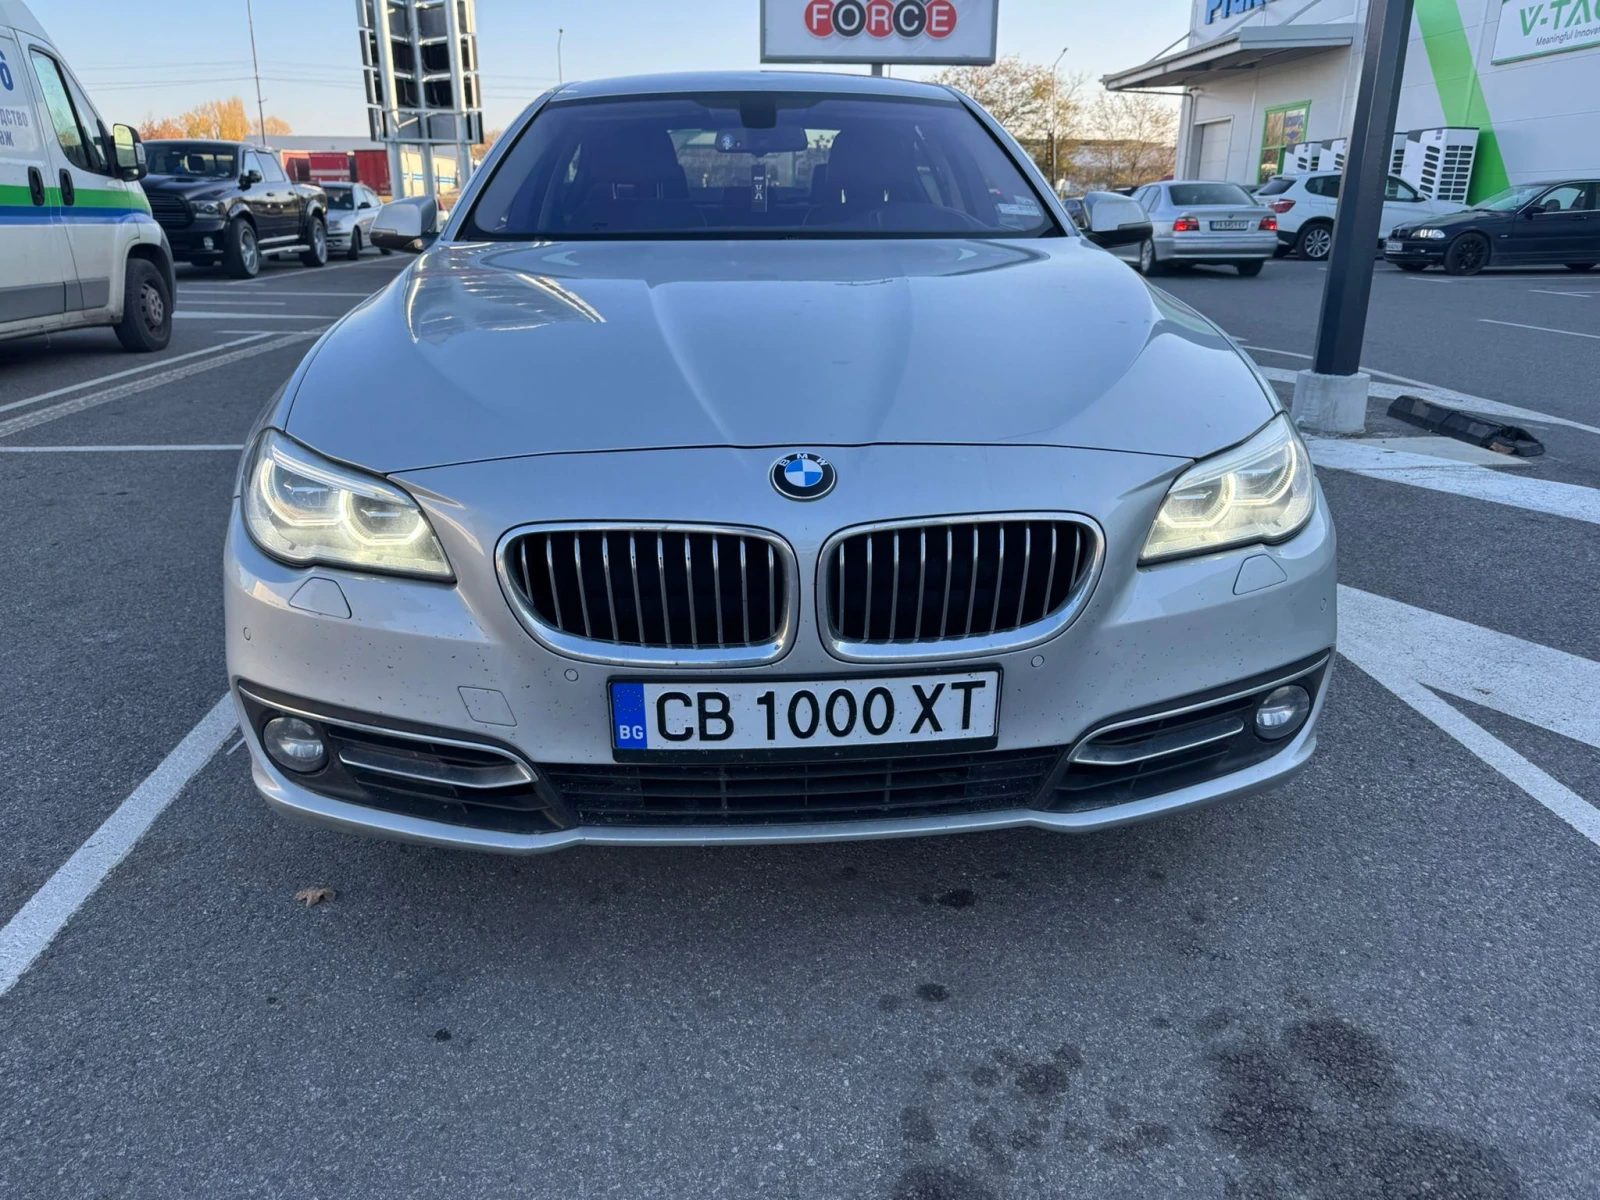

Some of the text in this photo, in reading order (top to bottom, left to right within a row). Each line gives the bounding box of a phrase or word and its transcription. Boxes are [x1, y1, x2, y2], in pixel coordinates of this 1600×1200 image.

[811, 4, 949, 31] FORCE
[1520, 0, 1600, 36] V-TA
[1536, 30, 1574, 46] Meaningful
[778, 453, 829, 467] BMW
[656, 679, 987, 742] CB 1000 XT
[619, 725, 645, 740] BG
